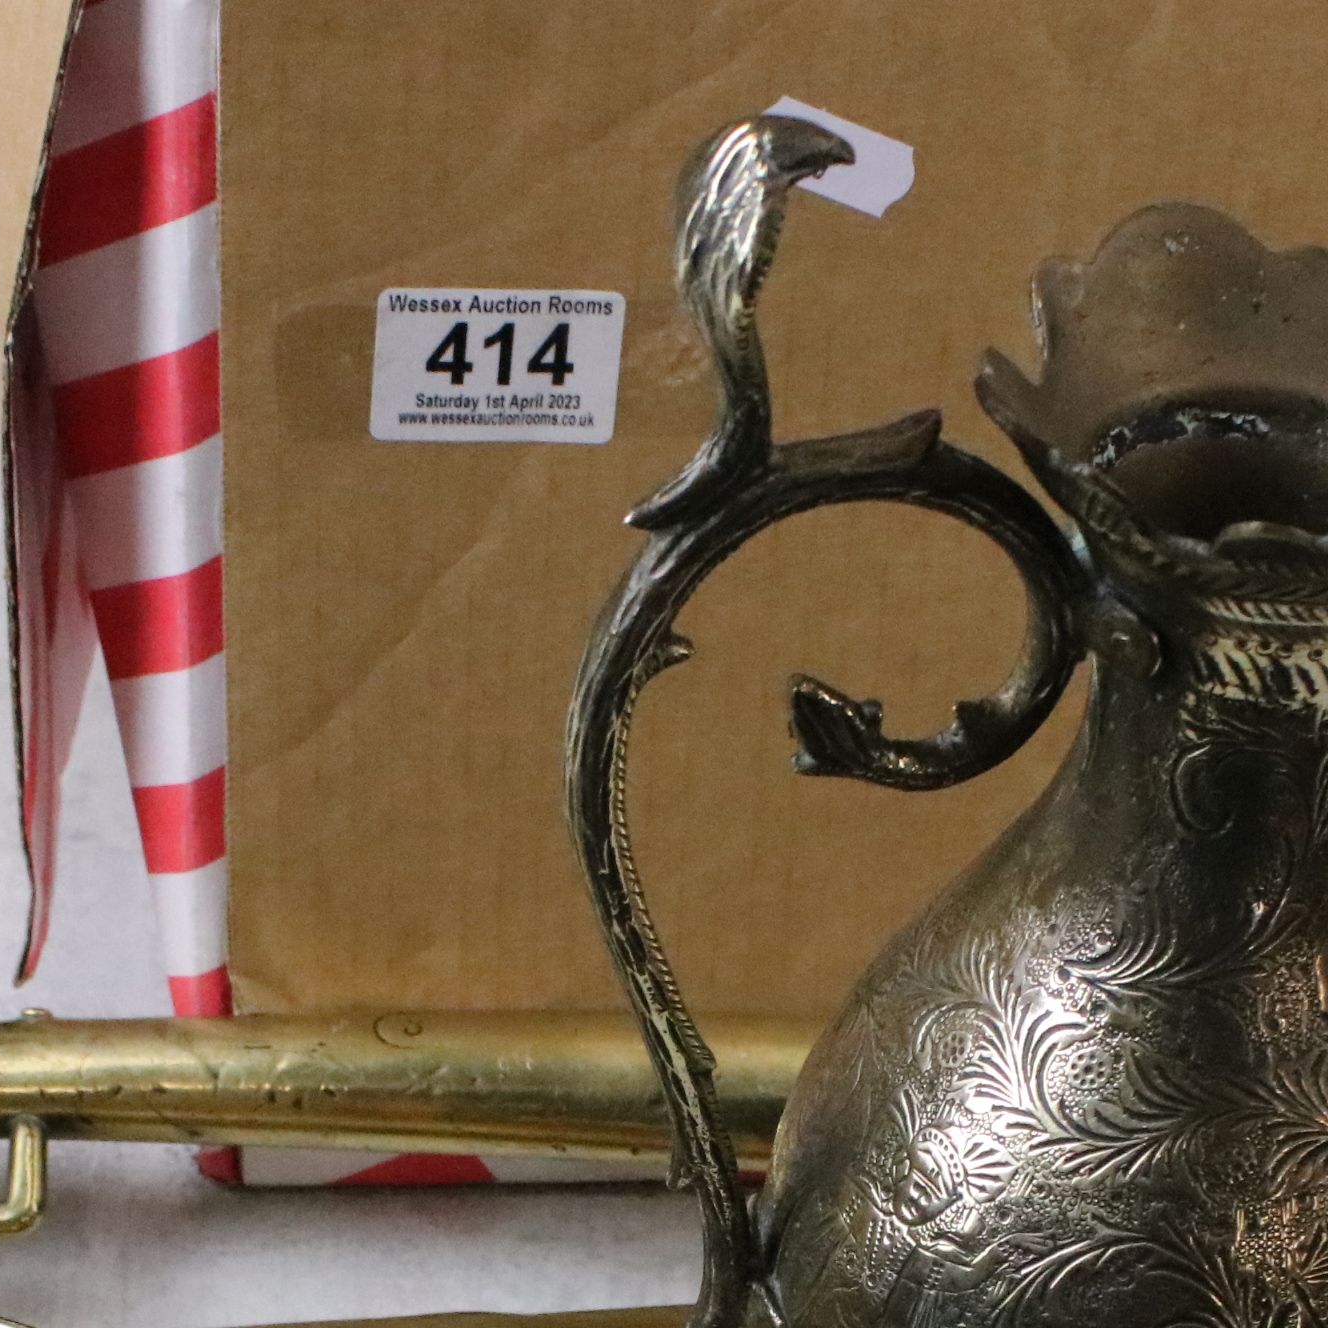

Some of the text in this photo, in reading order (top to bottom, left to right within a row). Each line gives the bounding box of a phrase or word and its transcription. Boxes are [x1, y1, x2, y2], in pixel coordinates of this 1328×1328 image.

[389, 294, 613, 316] Wessex Auction Rooms
[425, 321, 575, 386] 414
[415, 393, 581, 412] Saturday 1st April 2023
[398, 411, 595, 427] www.wessexauctionrooms.co.uk
